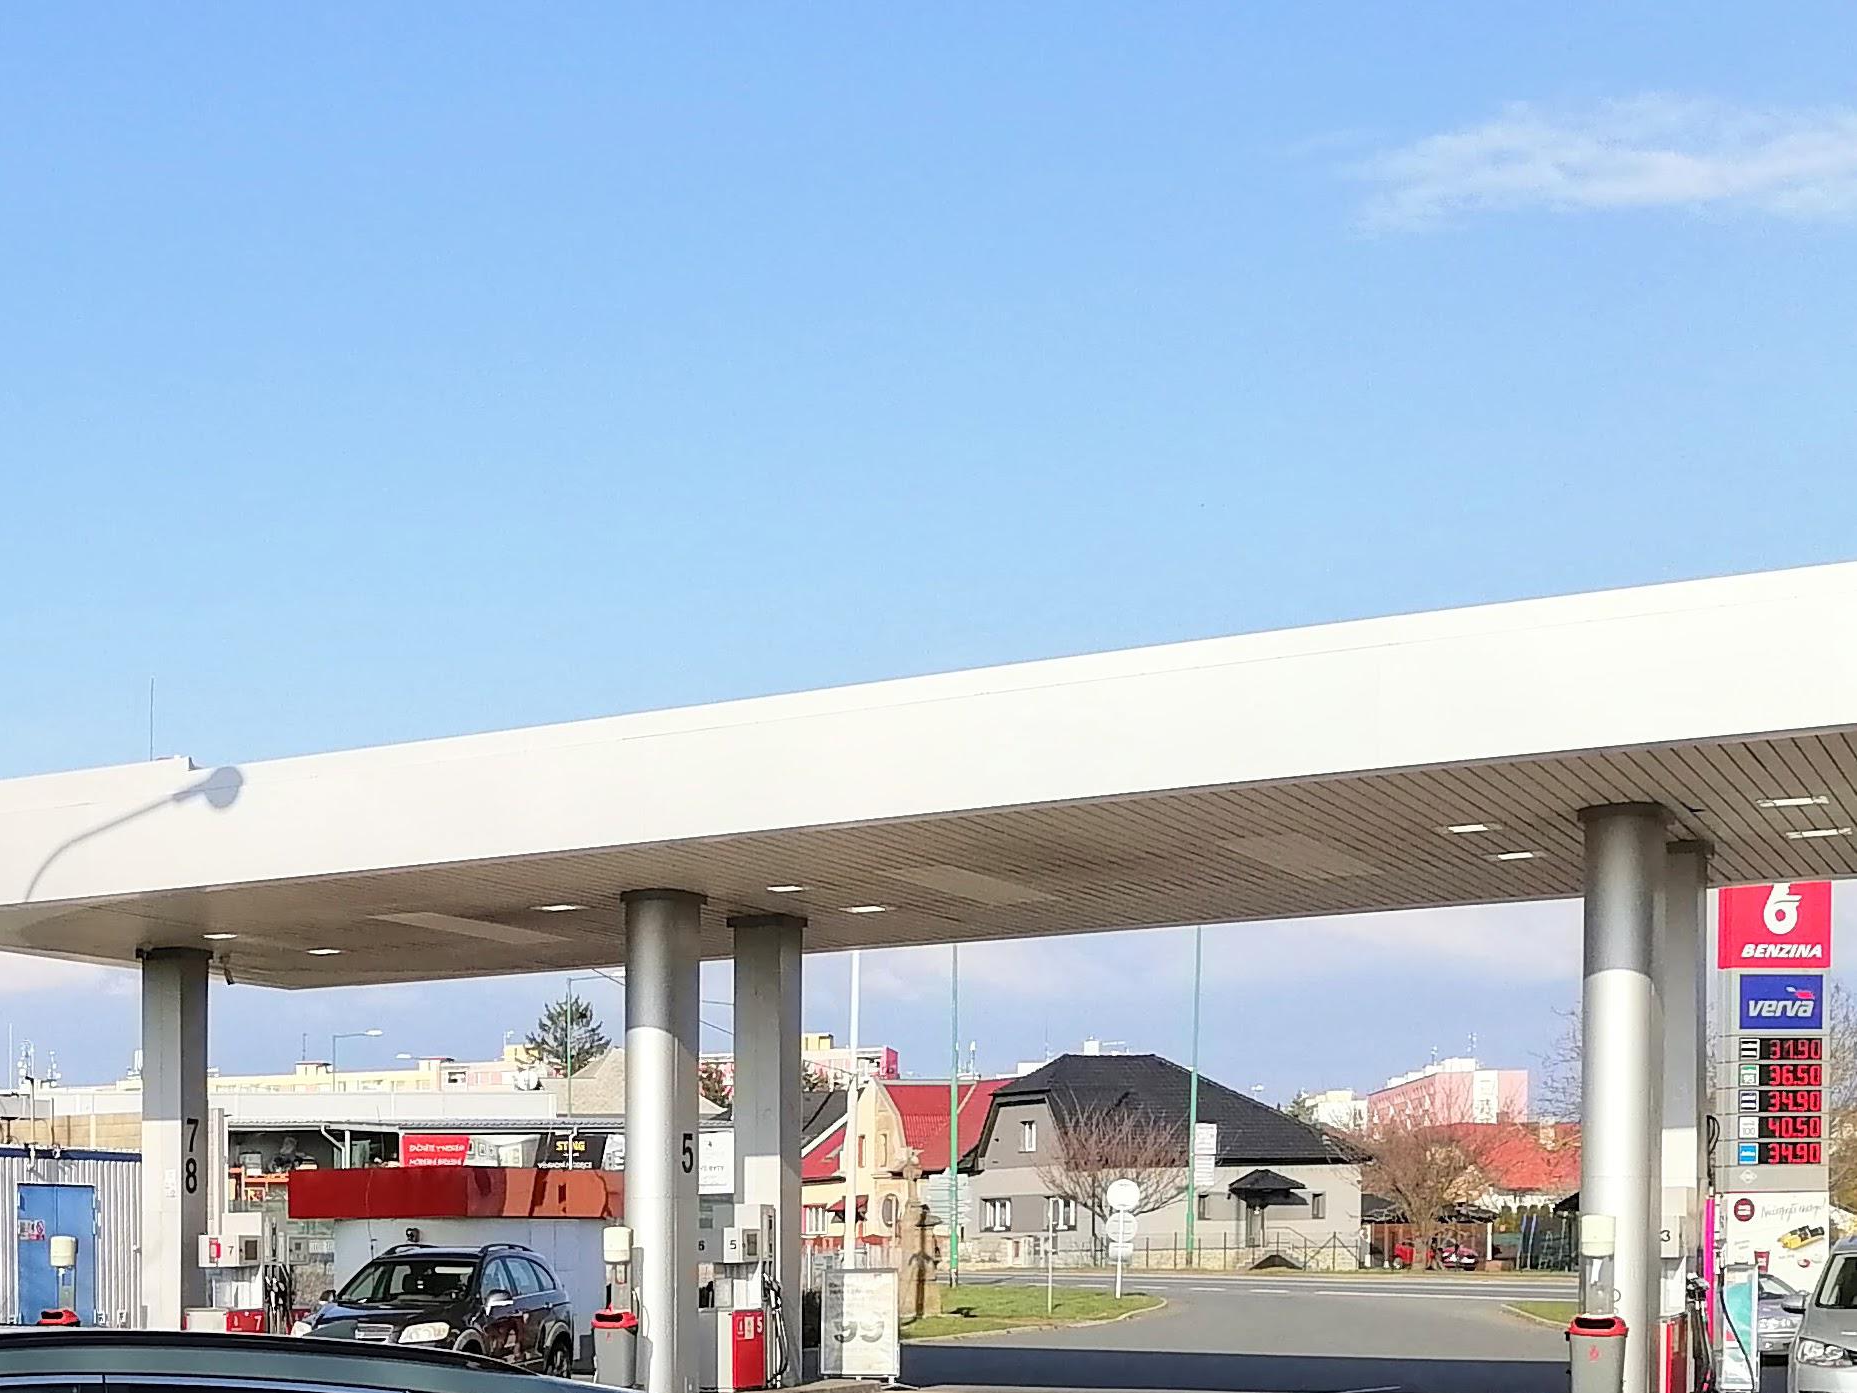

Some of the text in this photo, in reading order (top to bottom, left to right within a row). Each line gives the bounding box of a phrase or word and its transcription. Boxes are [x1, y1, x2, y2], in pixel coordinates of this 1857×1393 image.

[1741, 943, 1823, 958] BENZINA
[1748, 1000, 1815, 1017] verva
[1769, 1039, 1821, 1059] 31.90
[1768, 1064, 1821, 1085] 36.50
[1768, 1090, 1821, 1112] 34.90
[186, 1117, 199, 1153] 7
[1768, 1117, 1820, 1138] 40.50
[555, 1140, 586, 1152] STNG
[681, 1132, 694, 1174] 5
[1768, 1143, 1820, 1164] 34.90
[185, 1157, 198, 1194] 8
[227, 1245, 235, 1255] 7
[729, 1239, 737, 1250] 5
[253, 1315, 263, 1331] 7
[756, 1316, 763, 1334] 5
